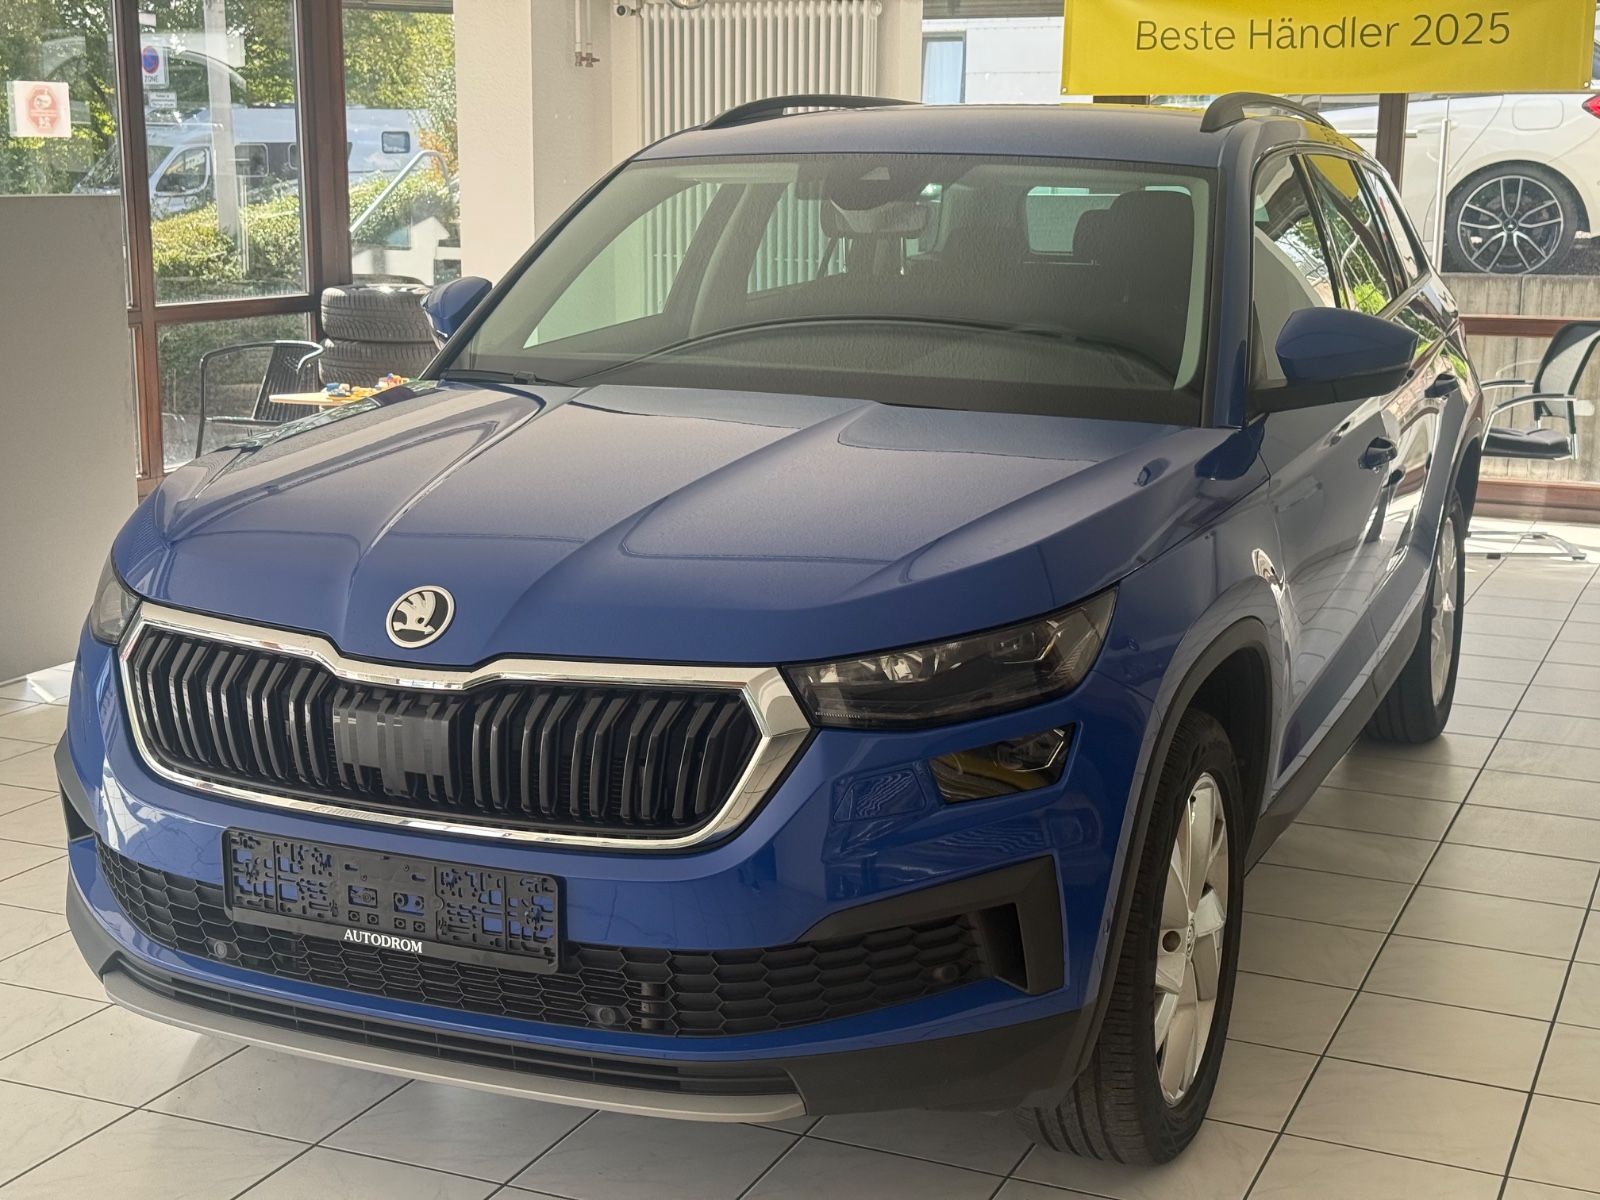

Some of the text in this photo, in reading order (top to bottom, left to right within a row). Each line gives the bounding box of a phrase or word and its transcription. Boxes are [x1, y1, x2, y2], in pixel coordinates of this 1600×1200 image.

[1136, 11, 1510, 50] Beste Händler 2025
[144, 75, 159, 83] ZONE
[343, 928, 423, 954] AUTODROM
